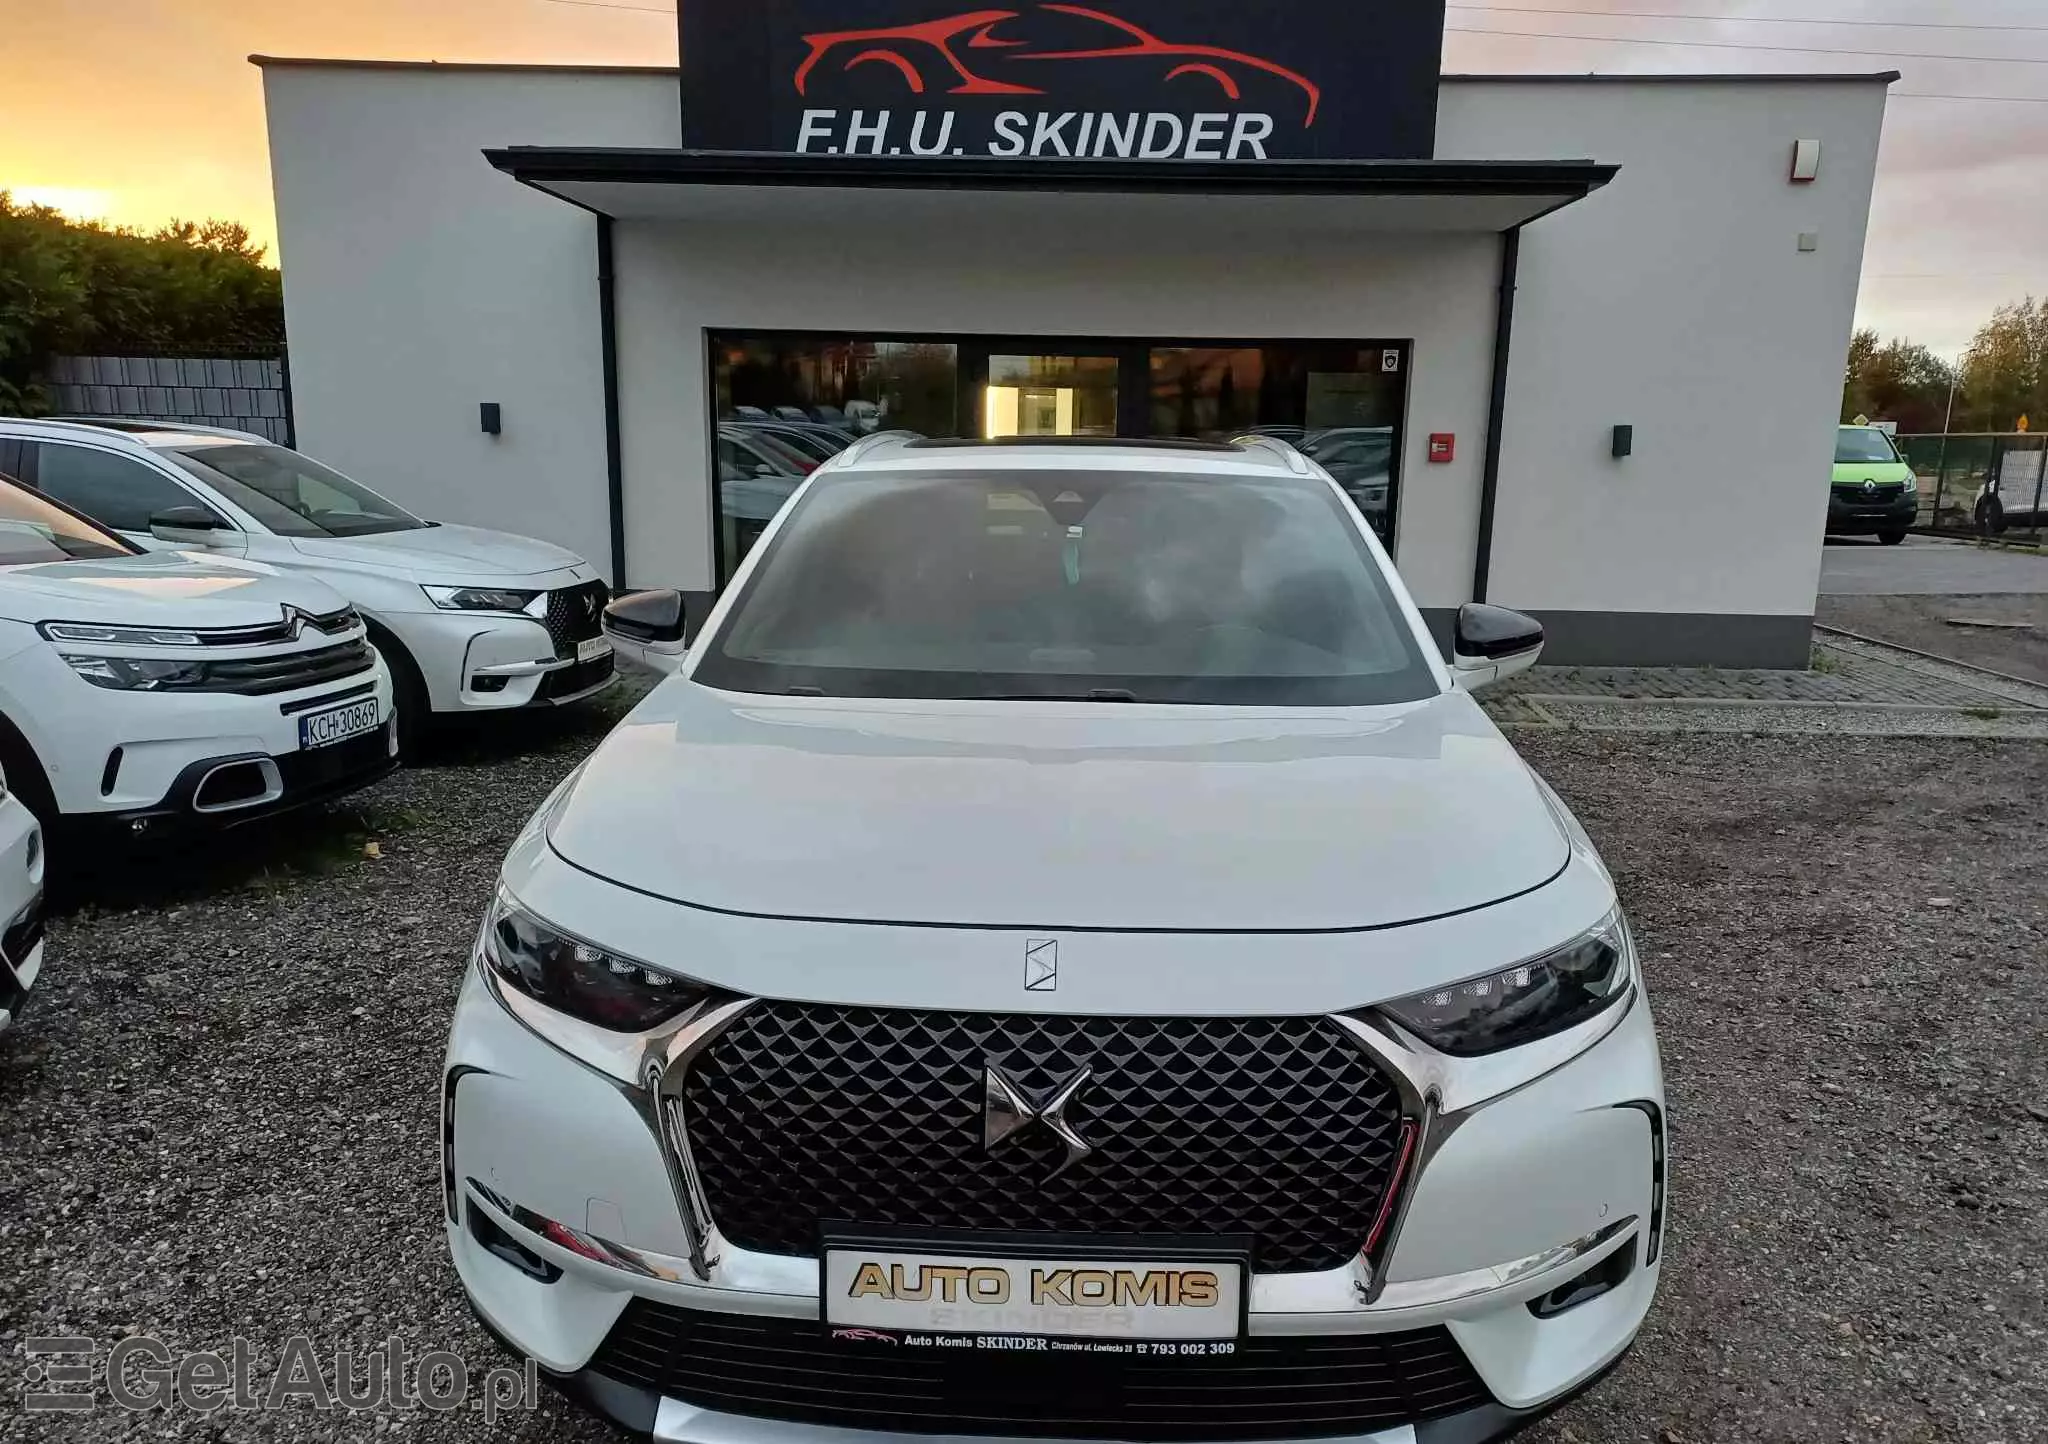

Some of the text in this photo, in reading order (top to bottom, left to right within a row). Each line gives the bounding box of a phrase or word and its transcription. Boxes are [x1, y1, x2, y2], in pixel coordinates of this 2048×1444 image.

[795, 109, 1273, 160] F.H.U. SKINDER
[309, 702, 375, 743] KCH 30869
[848, 1262, 1218, 1307] AUTO KOMIS
[904, 1334, 932, 1346] Auto
[936, 1336, 973, 1348] Komis
[976, 1336, 1048, 1351] SKINDER
[1151, 1343, 1176, 1355] 793
[1180, 1343, 1206, 1355] 002
[1209, 1342, 1235, 1354] 309
